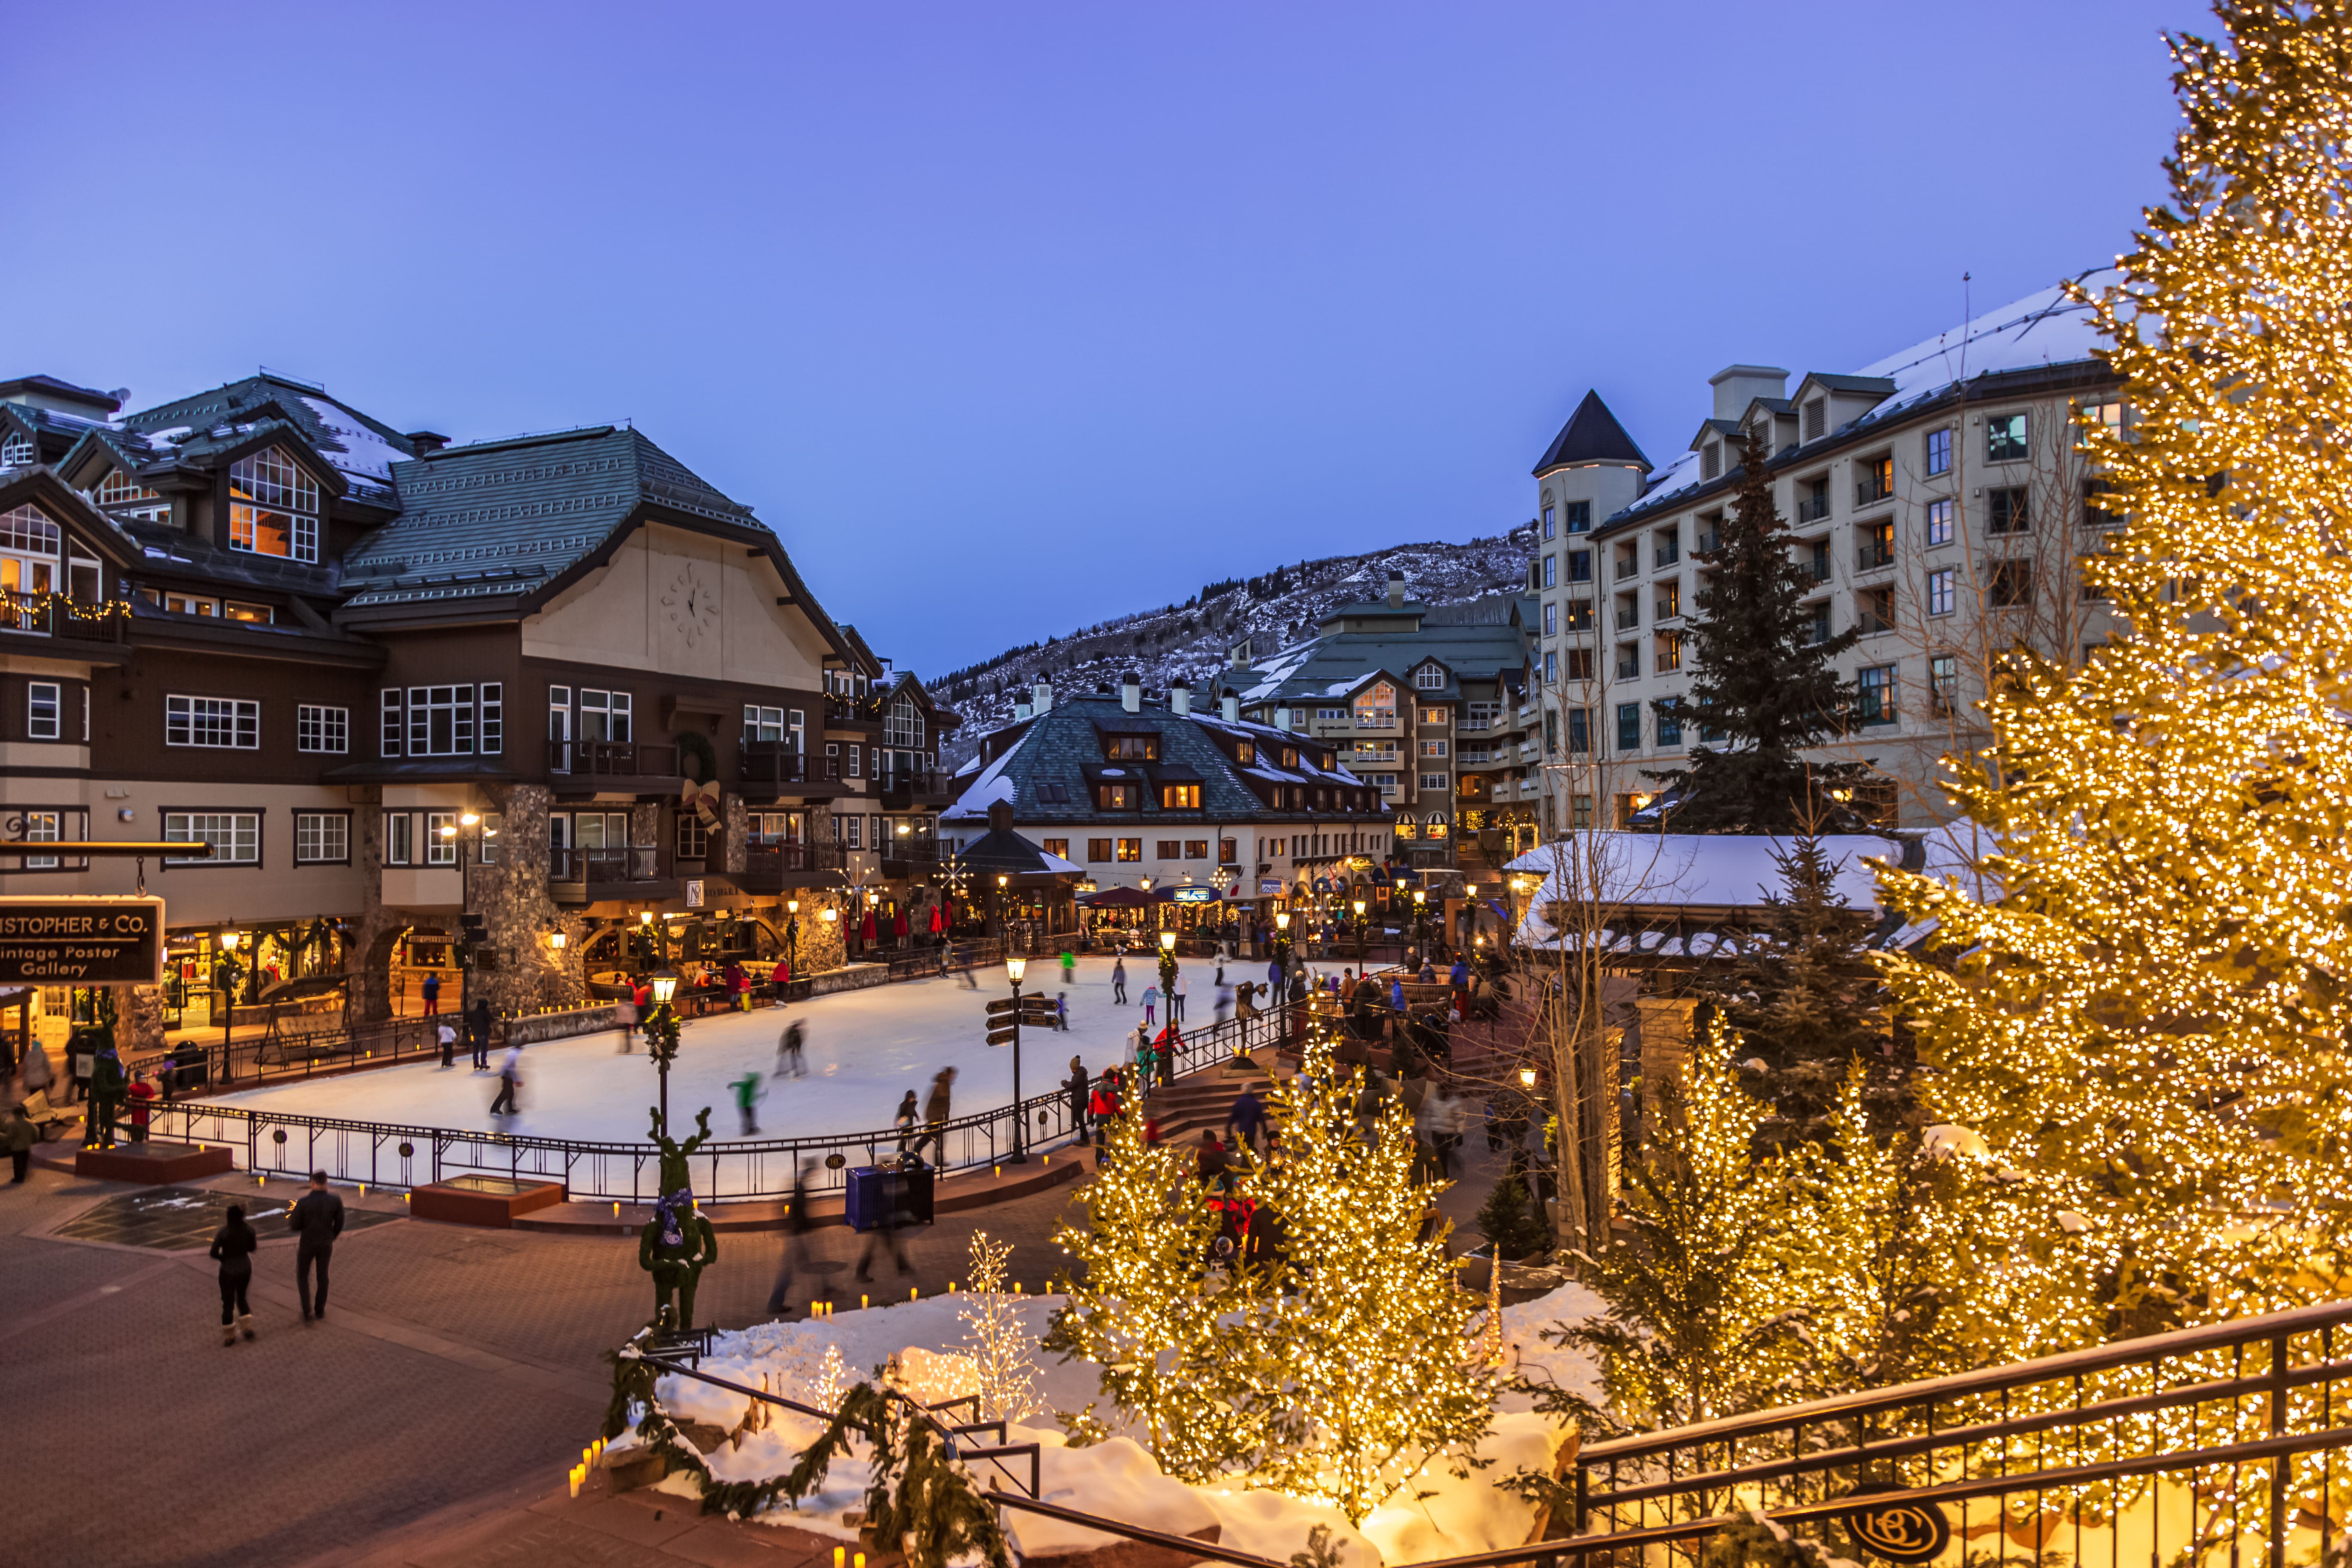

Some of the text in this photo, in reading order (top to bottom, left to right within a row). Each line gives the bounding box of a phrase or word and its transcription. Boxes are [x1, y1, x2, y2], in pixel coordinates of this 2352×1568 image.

[99, 918, 110, 930] &
[66, 946, 120, 958] Poster
[21, 962, 87, 977] Gallery
